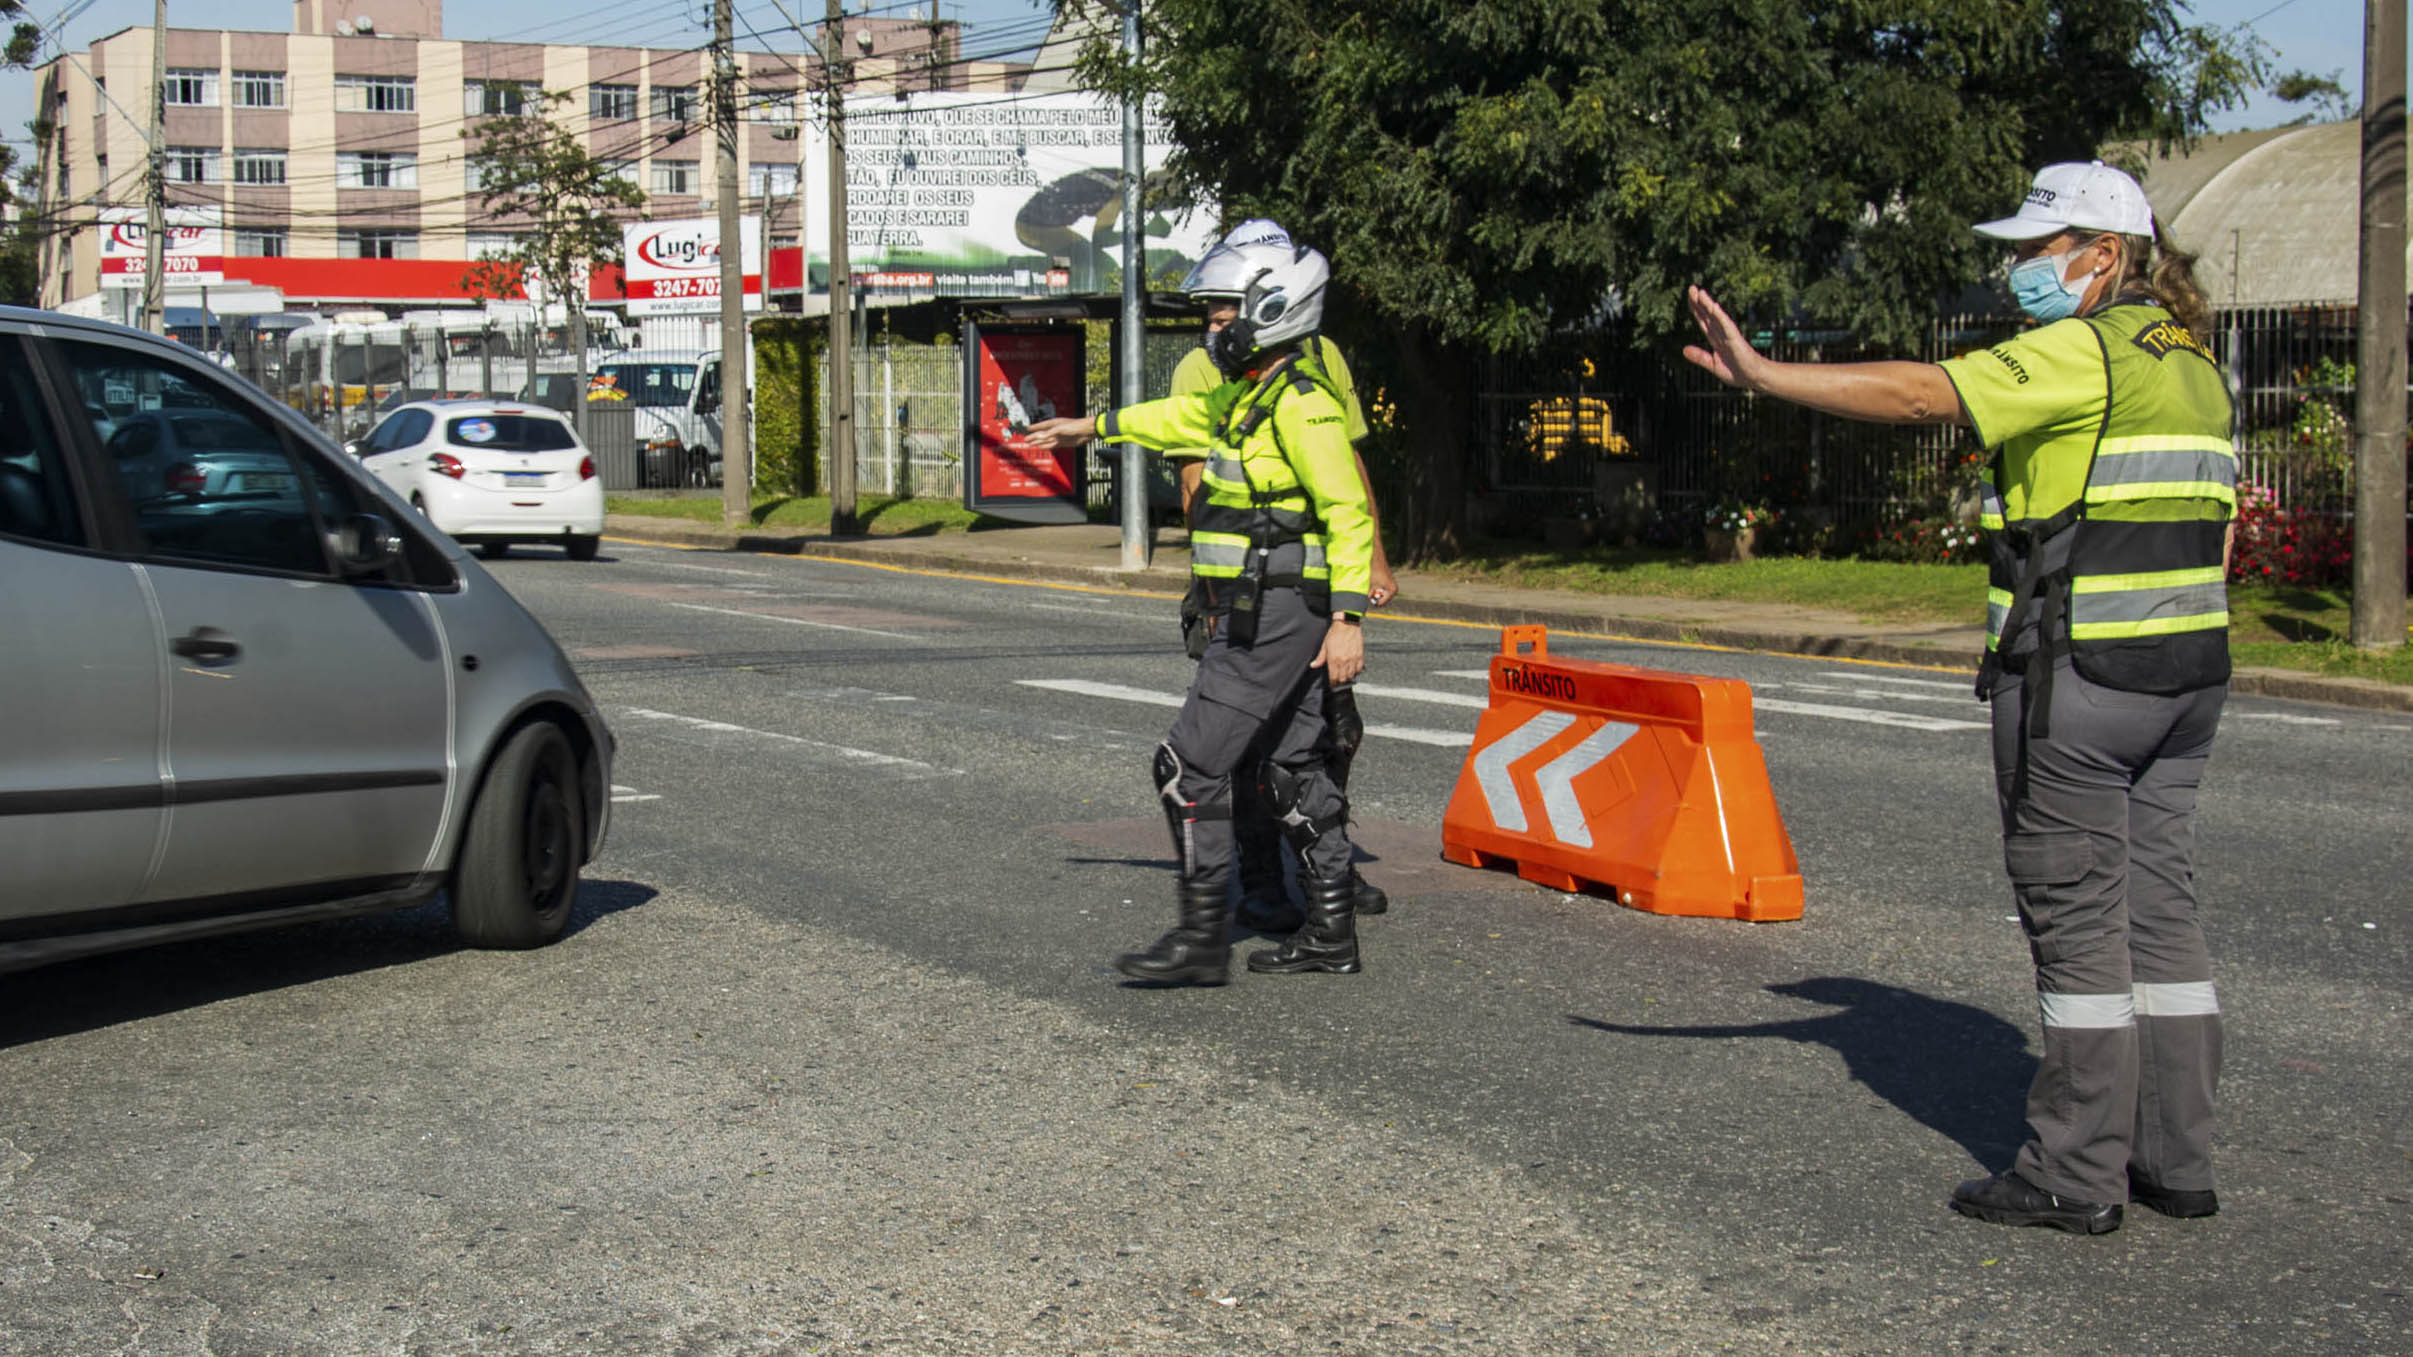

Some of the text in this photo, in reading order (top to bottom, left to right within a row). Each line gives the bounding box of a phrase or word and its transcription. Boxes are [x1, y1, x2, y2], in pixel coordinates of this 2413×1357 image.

[944, 110, 973, 125] QUE
[975, 110, 994, 125] SE
[996, 110, 1047, 125] CHAMA
[1048, 110, 1087, 125] PELO
[1088, 109, 1120, 125] MEU
[850, 129, 929, 147] HUMILHAR,
[931, 130, 943, 145] E
[945, 130, 989, 147] ORAR,
[990, 130, 1003, 145] E
[1028, 130, 1089, 147] BUSCAR,
[1092, 130, 1104, 145] E
[845, 150, 864, 165] OS
[865, 149, 903, 165] SEUS
[948, 150, 1029, 167] CAMINHOS,
[847, 167, 880, 187] TÃO,
[909, 170, 966, 186] OUVIREI
[968, 170, 997, 186] DOS
[999, 168, 1042, 188] CÉUS,
[847, 189, 974, 206] RDOAREI OS SEUS
[847, 209, 970, 226] CADOS E SARAREI
[872, 230, 923, 247] TERRA,
[653, 278, 722, 298] 3247-707
[936, 273, 966, 286] visite
[968, 273, 1014, 286] também
[1502, 663, 1577, 701] TRÂNSITO
